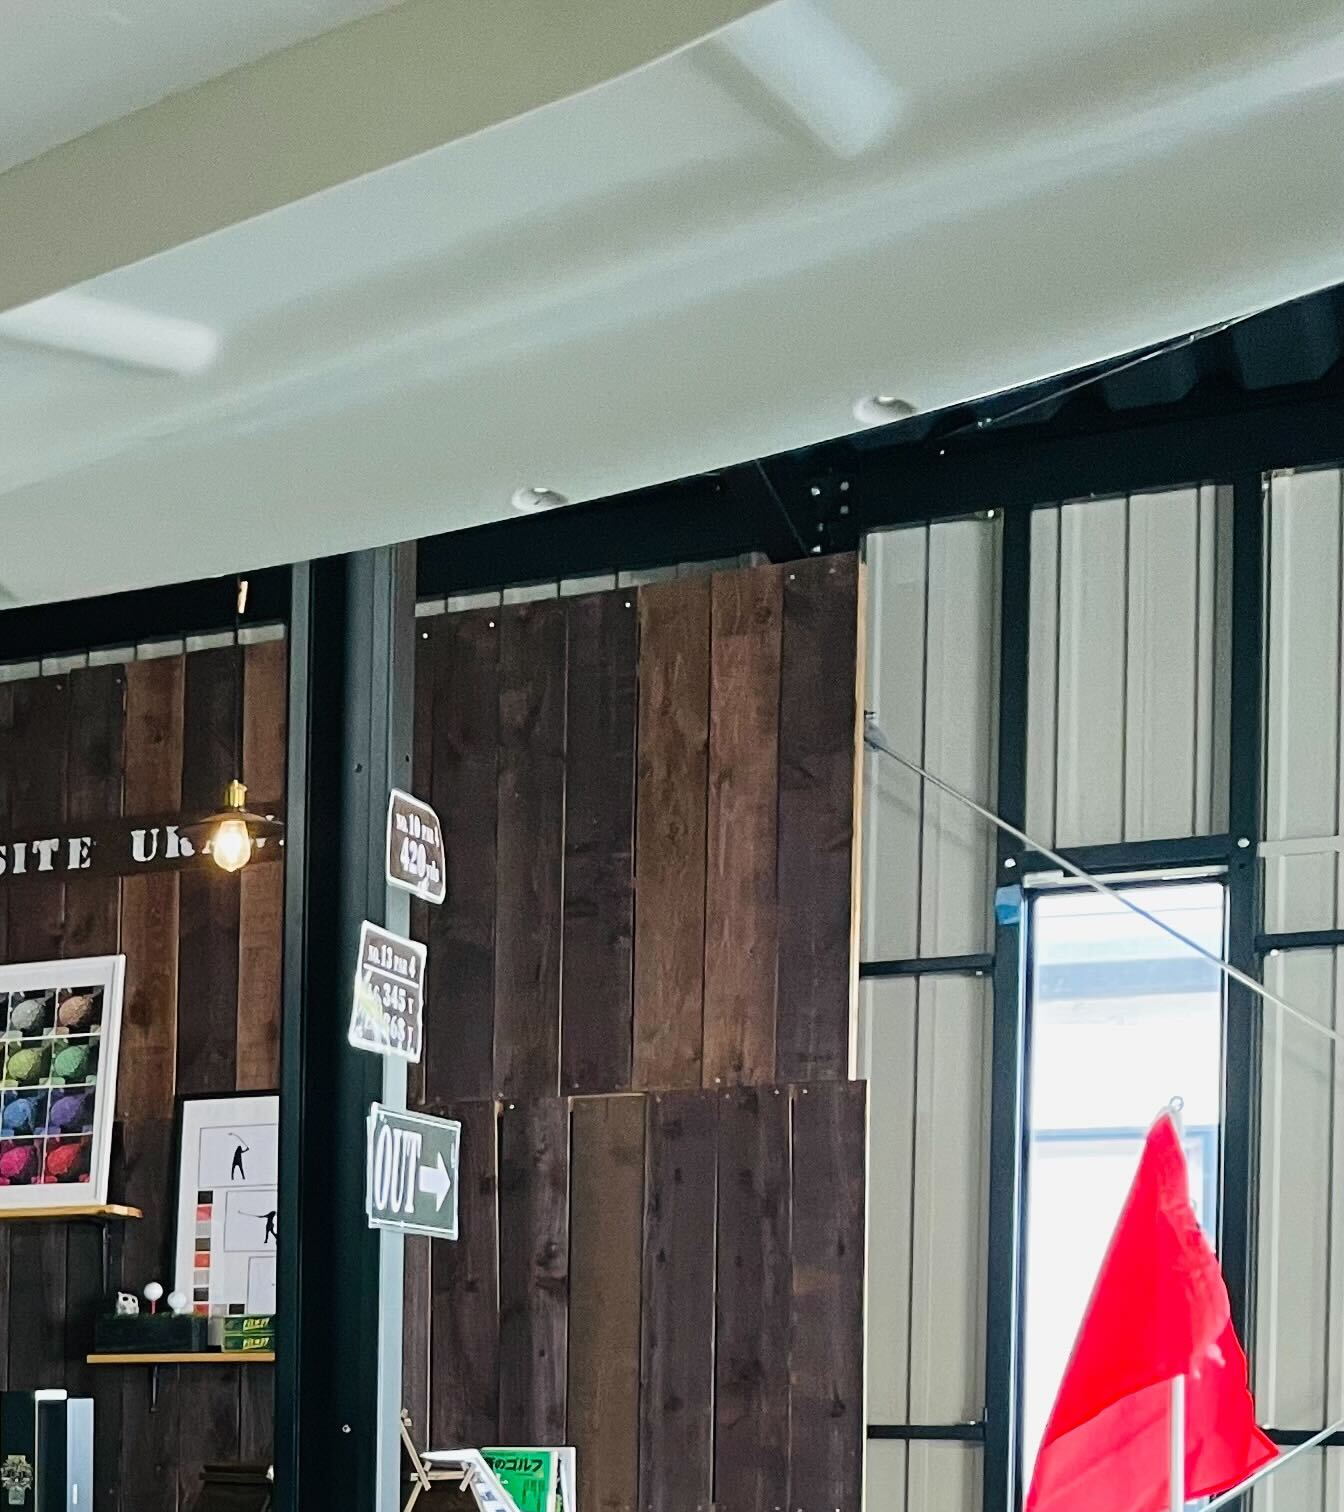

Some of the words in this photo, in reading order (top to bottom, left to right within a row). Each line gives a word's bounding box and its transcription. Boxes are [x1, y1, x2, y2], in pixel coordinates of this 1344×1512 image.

[399, 836, 427, 878] 420
[382, 982, 407, 1013] 345
[374, 1124, 422, 1213] OUT
